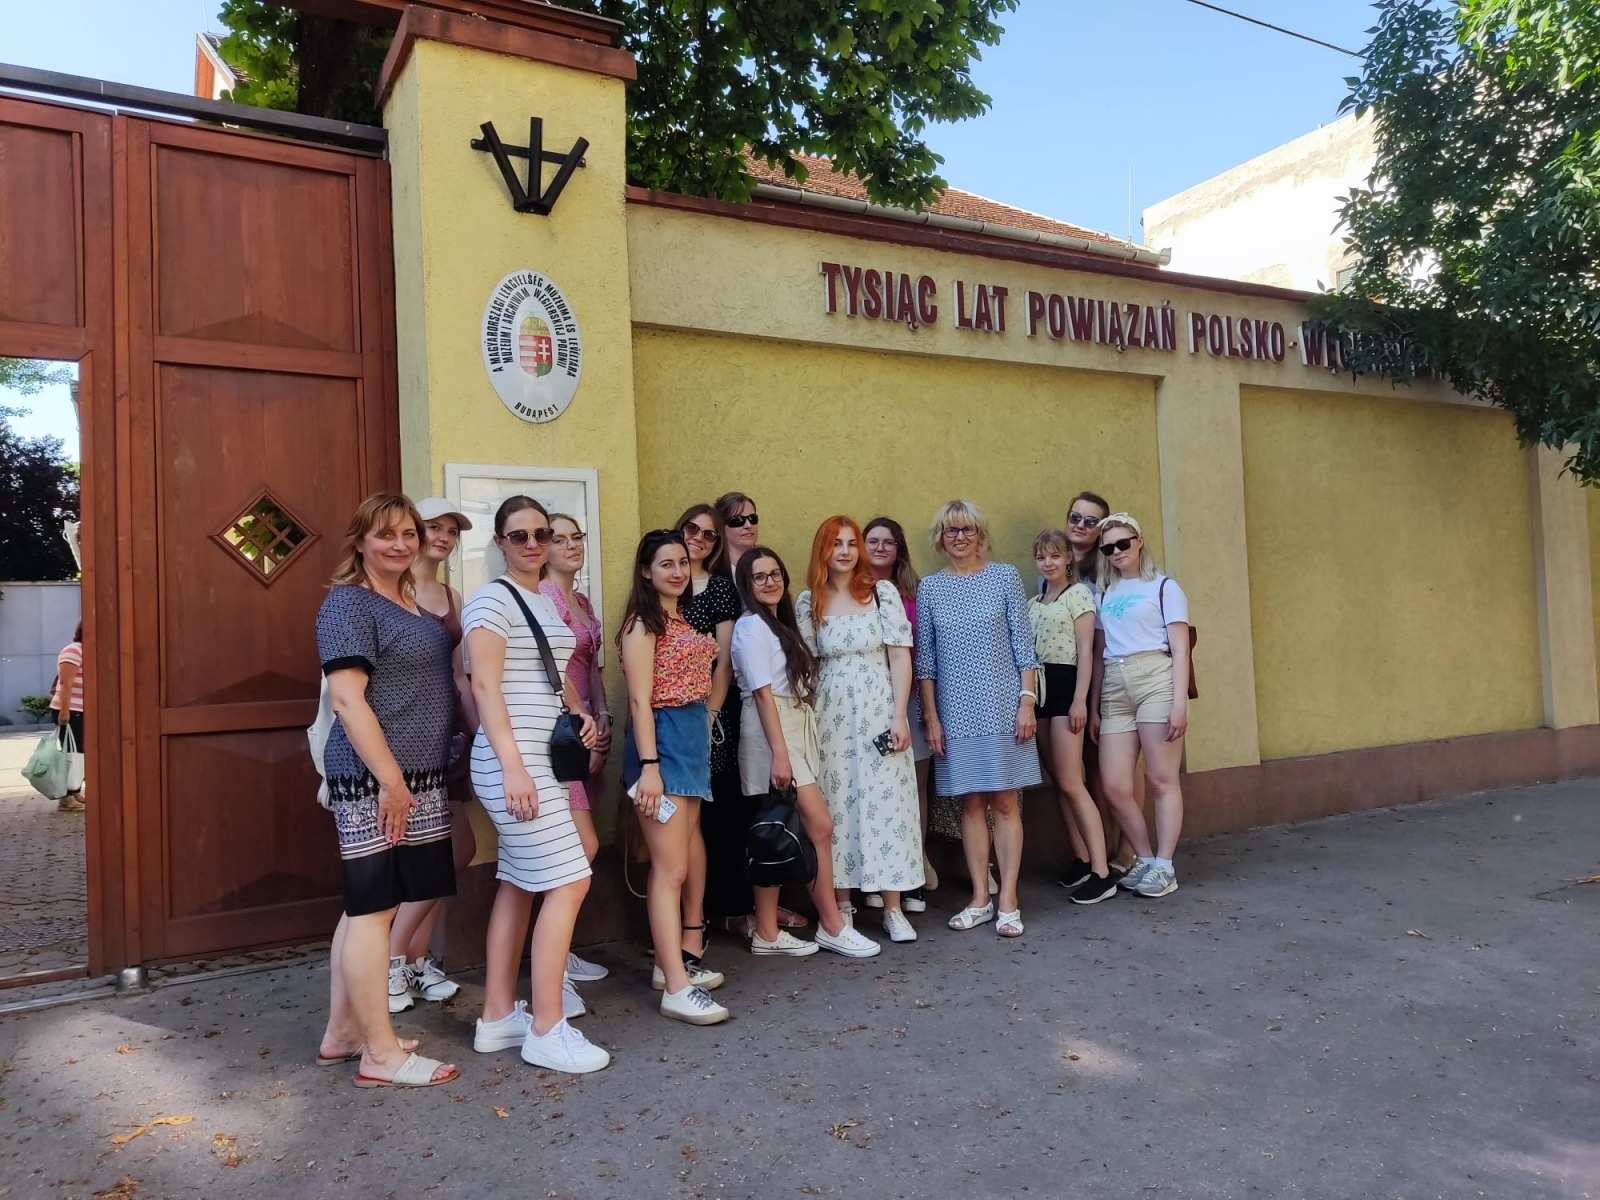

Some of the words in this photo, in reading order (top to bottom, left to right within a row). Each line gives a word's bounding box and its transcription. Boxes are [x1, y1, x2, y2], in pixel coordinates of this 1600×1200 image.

[486, 296, 506, 364] MAGYARORSZÁGI
[498, 274, 544, 299] LENGYELSÉG
[565, 323, 576, 333] ÉS
[502, 287, 530, 325] ARCHIWUM
[819, 261, 938, 331] TYSIĄC
[954, 280, 1008, 333] LAT
[1024, 290, 1177, 352] POWIĄZAŃ
[500, 332, 514, 363] MUZEUM
[557, 338, 568, 368] POLONII
[514, 402, 559, 419] BUDAPEST
